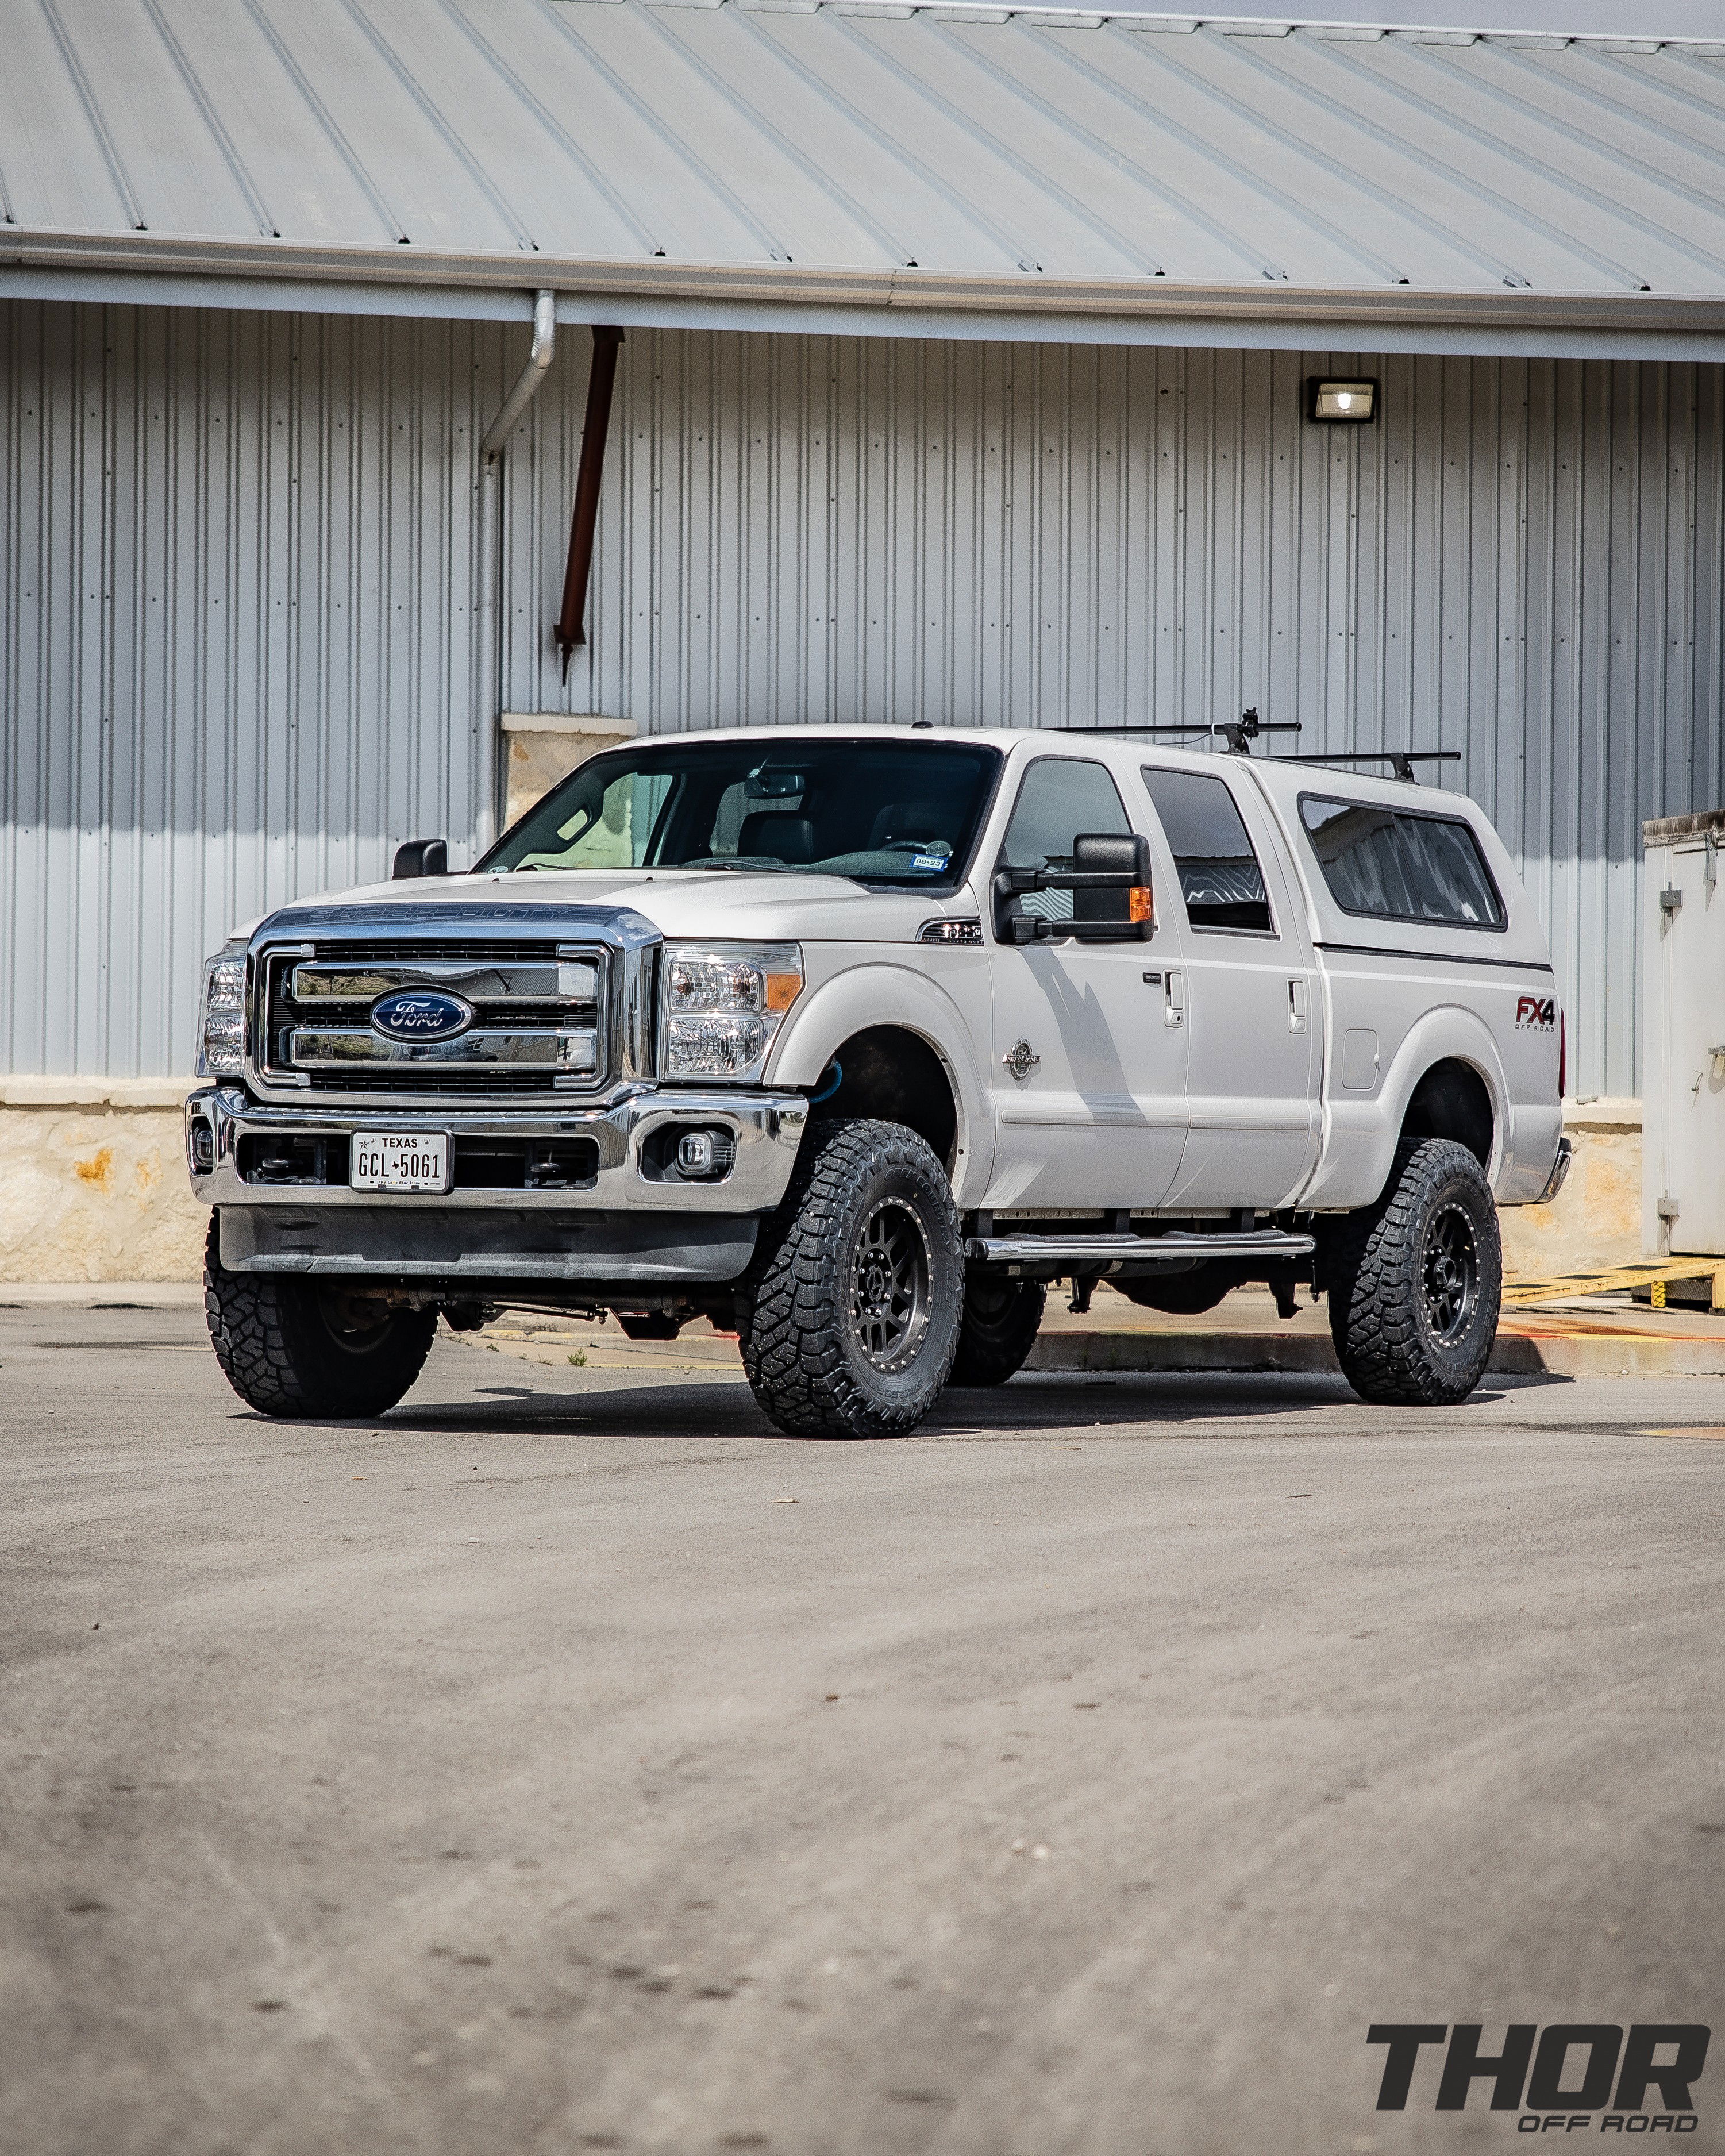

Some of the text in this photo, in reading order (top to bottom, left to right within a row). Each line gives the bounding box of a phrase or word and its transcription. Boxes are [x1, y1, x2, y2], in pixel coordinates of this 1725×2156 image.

[308, 906, 575, 919] SUPER DUTY
[390, 1001, 444, 1026] Ford
[1516, 996, 1555, 1025] FX4
[382, 1138, 418, 1148] TEXAS
[884, 1167, 918, 1181] OPEN
